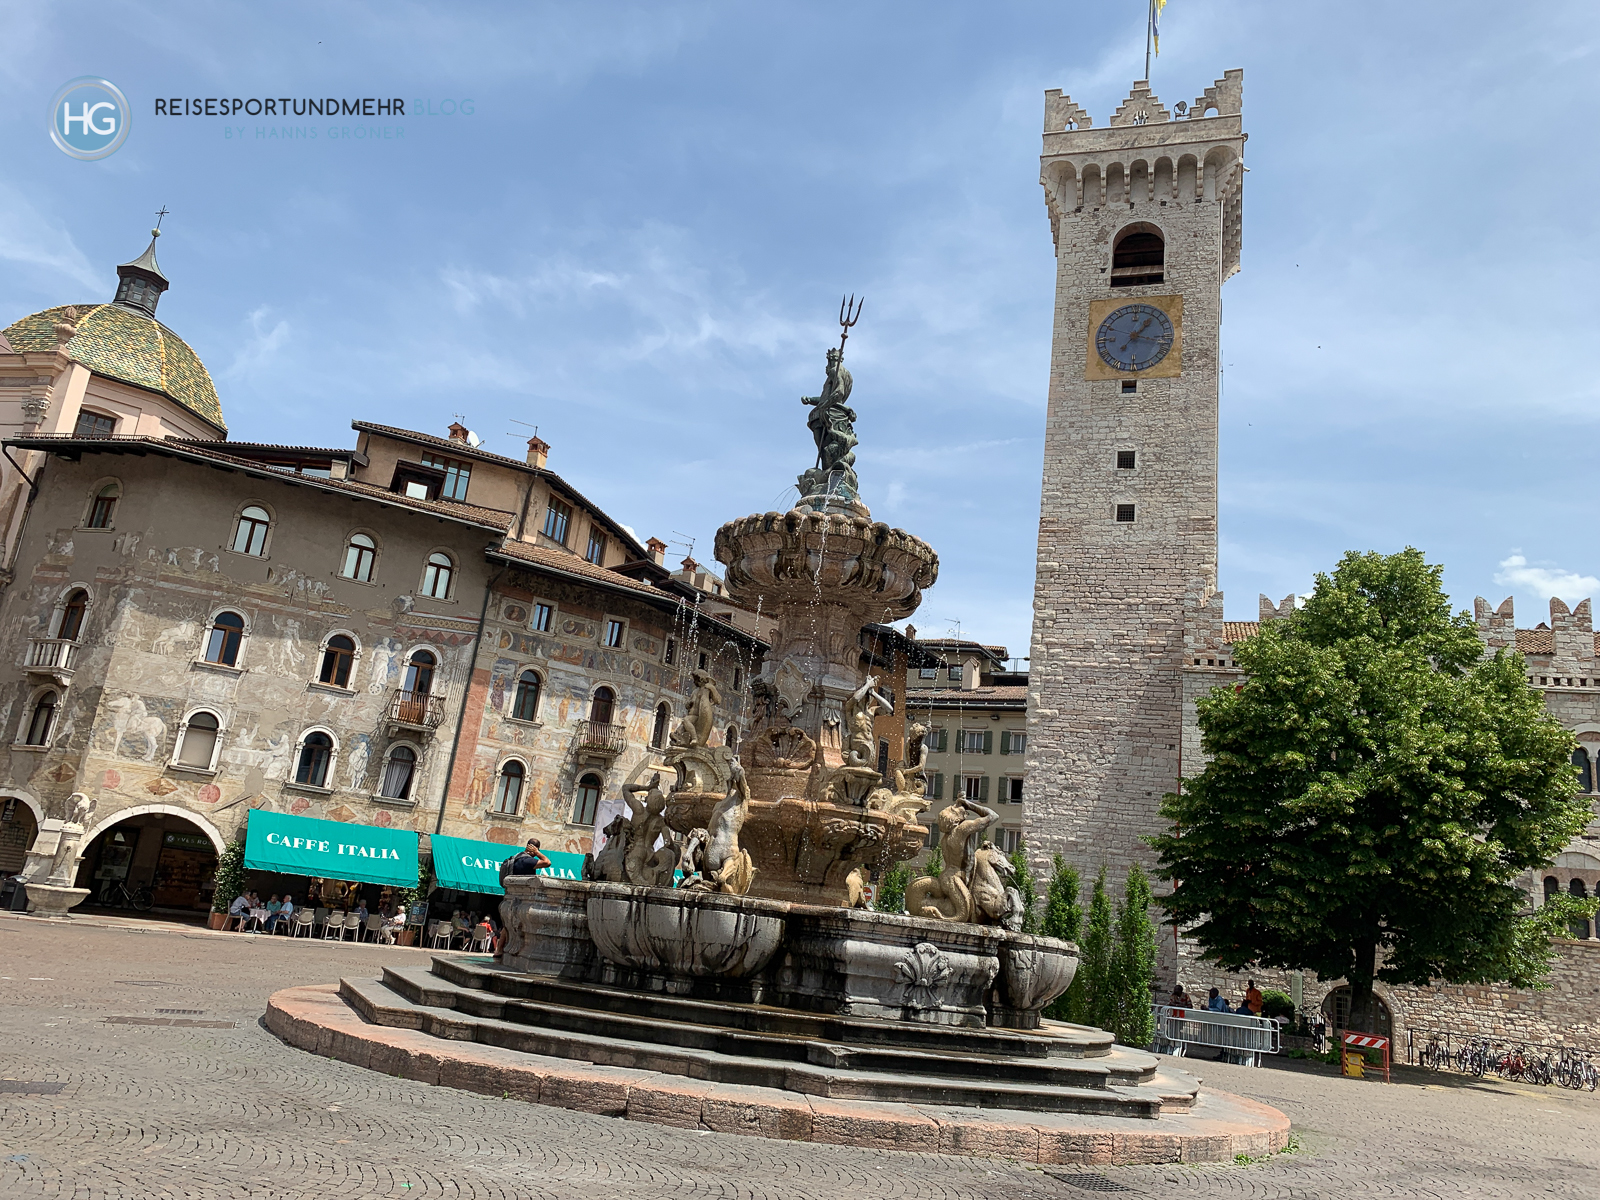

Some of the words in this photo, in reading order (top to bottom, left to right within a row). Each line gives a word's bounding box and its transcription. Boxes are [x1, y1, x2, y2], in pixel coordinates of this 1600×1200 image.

[337, 843, 400, 860] ITALIA
[461, 855, 504, 873] CAFF
[536, 866, 577, 880] ALIA
